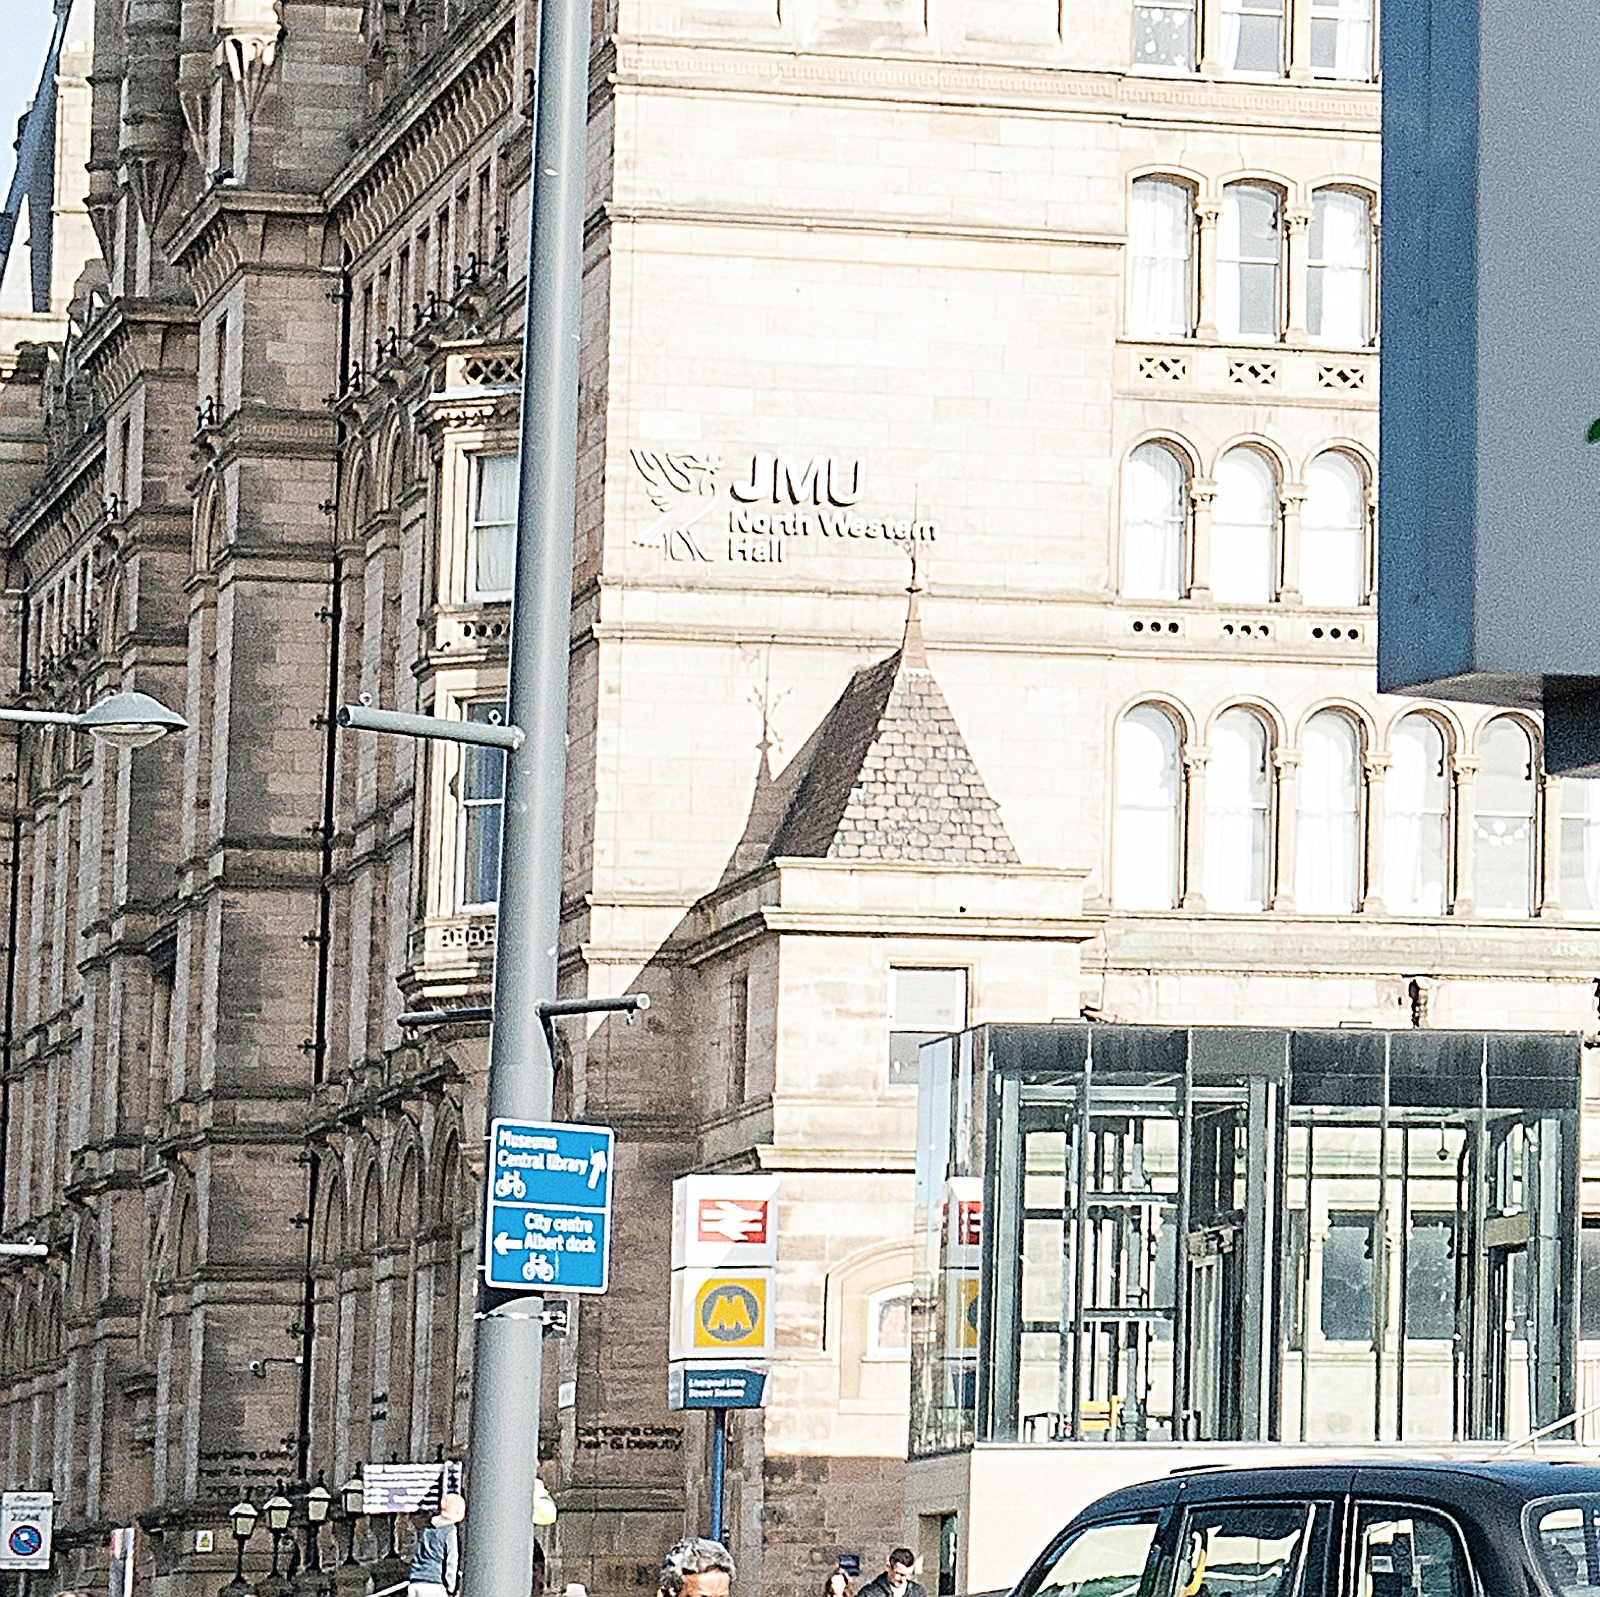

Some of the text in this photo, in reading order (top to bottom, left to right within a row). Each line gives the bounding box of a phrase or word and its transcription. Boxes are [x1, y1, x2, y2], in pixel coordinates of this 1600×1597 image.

[729, 452, 866, 507] JMU
[729, 508, 940, 541] North Western
[728, 536, 787, 562] Hall
[498, 1129, 558, 1152] Museums
[497, 1148, 589, 1176] Central library
[524, 1211, 594, 1235] City centre
[524, 1231, 597, 1254] Albert dock
[610, 1437, 624, 1450] &
